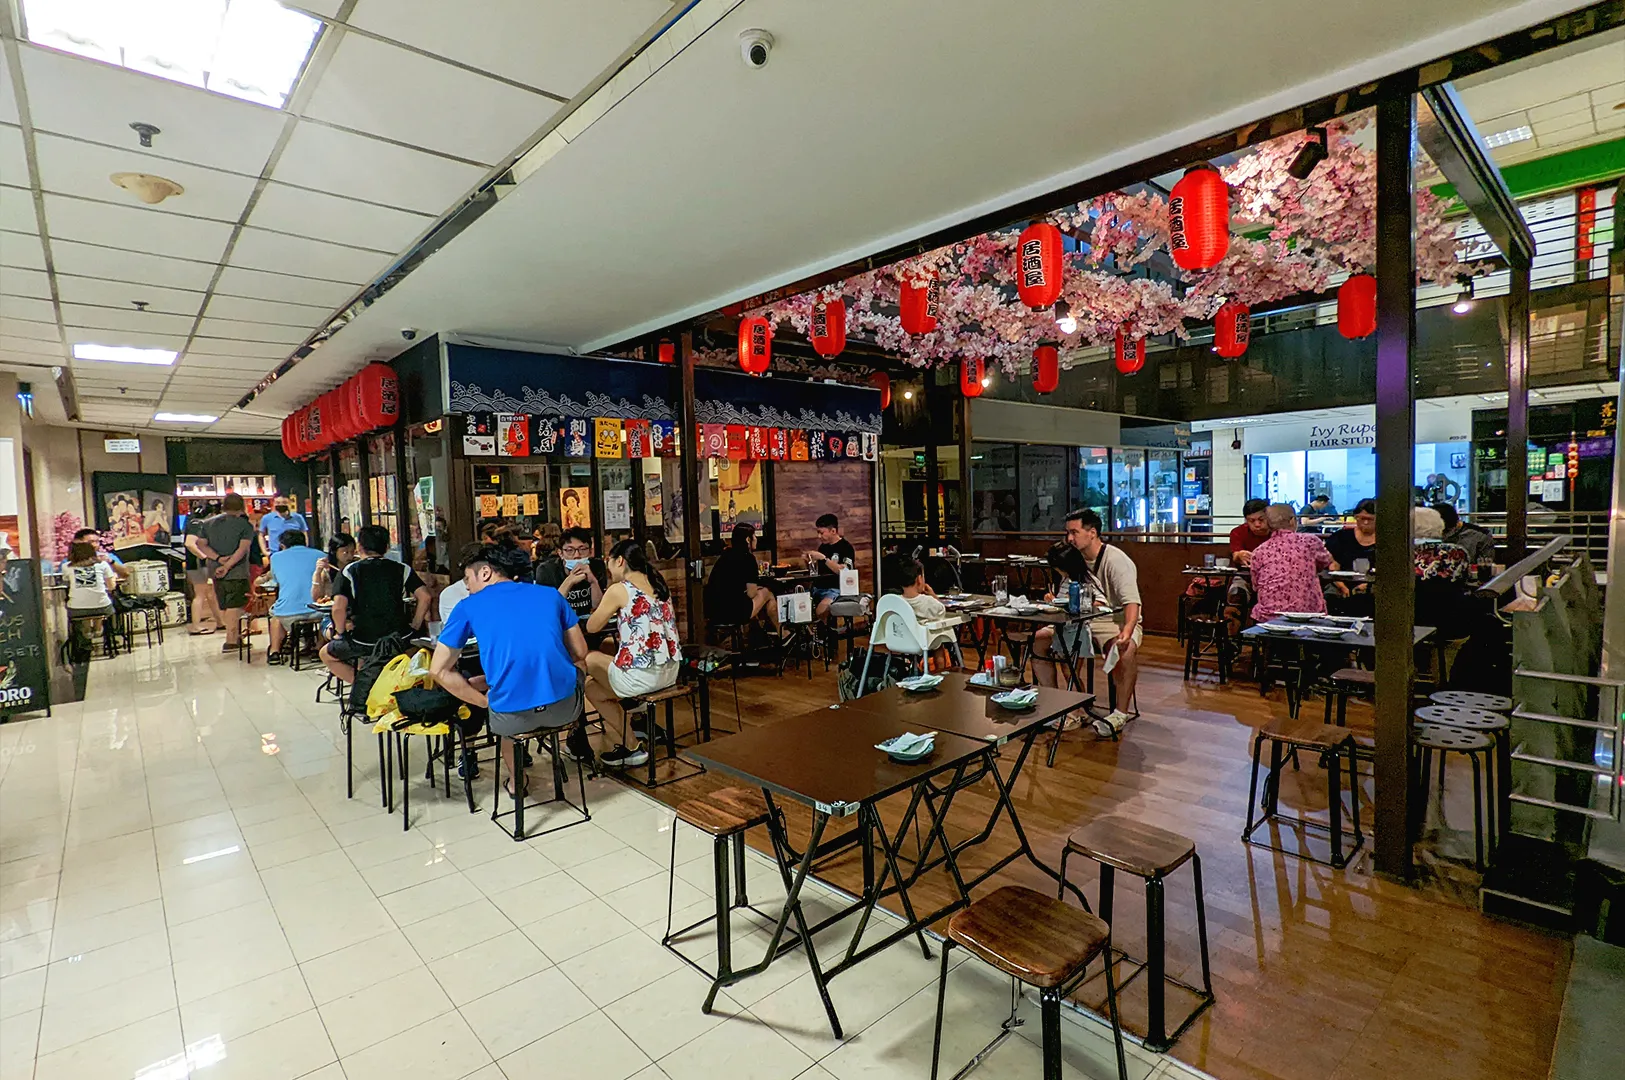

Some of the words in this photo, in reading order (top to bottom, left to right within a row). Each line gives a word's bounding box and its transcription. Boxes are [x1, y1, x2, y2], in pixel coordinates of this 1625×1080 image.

[1022, 240, 1047, 288] 居酒屋
[926, 278, 941, 319] 居酒屋
[752, 324, 767, 356] 居酒屋
[466, 414, 478, 435] 定食
[1310, 426, 1335, 439] Ivy
[597, 441, 619, 451] ビール
[1310, 439, 1339, 448] HAIR
[1341, 436, 1374, 446] STUD
[5, 700, 31, 708] BEER
